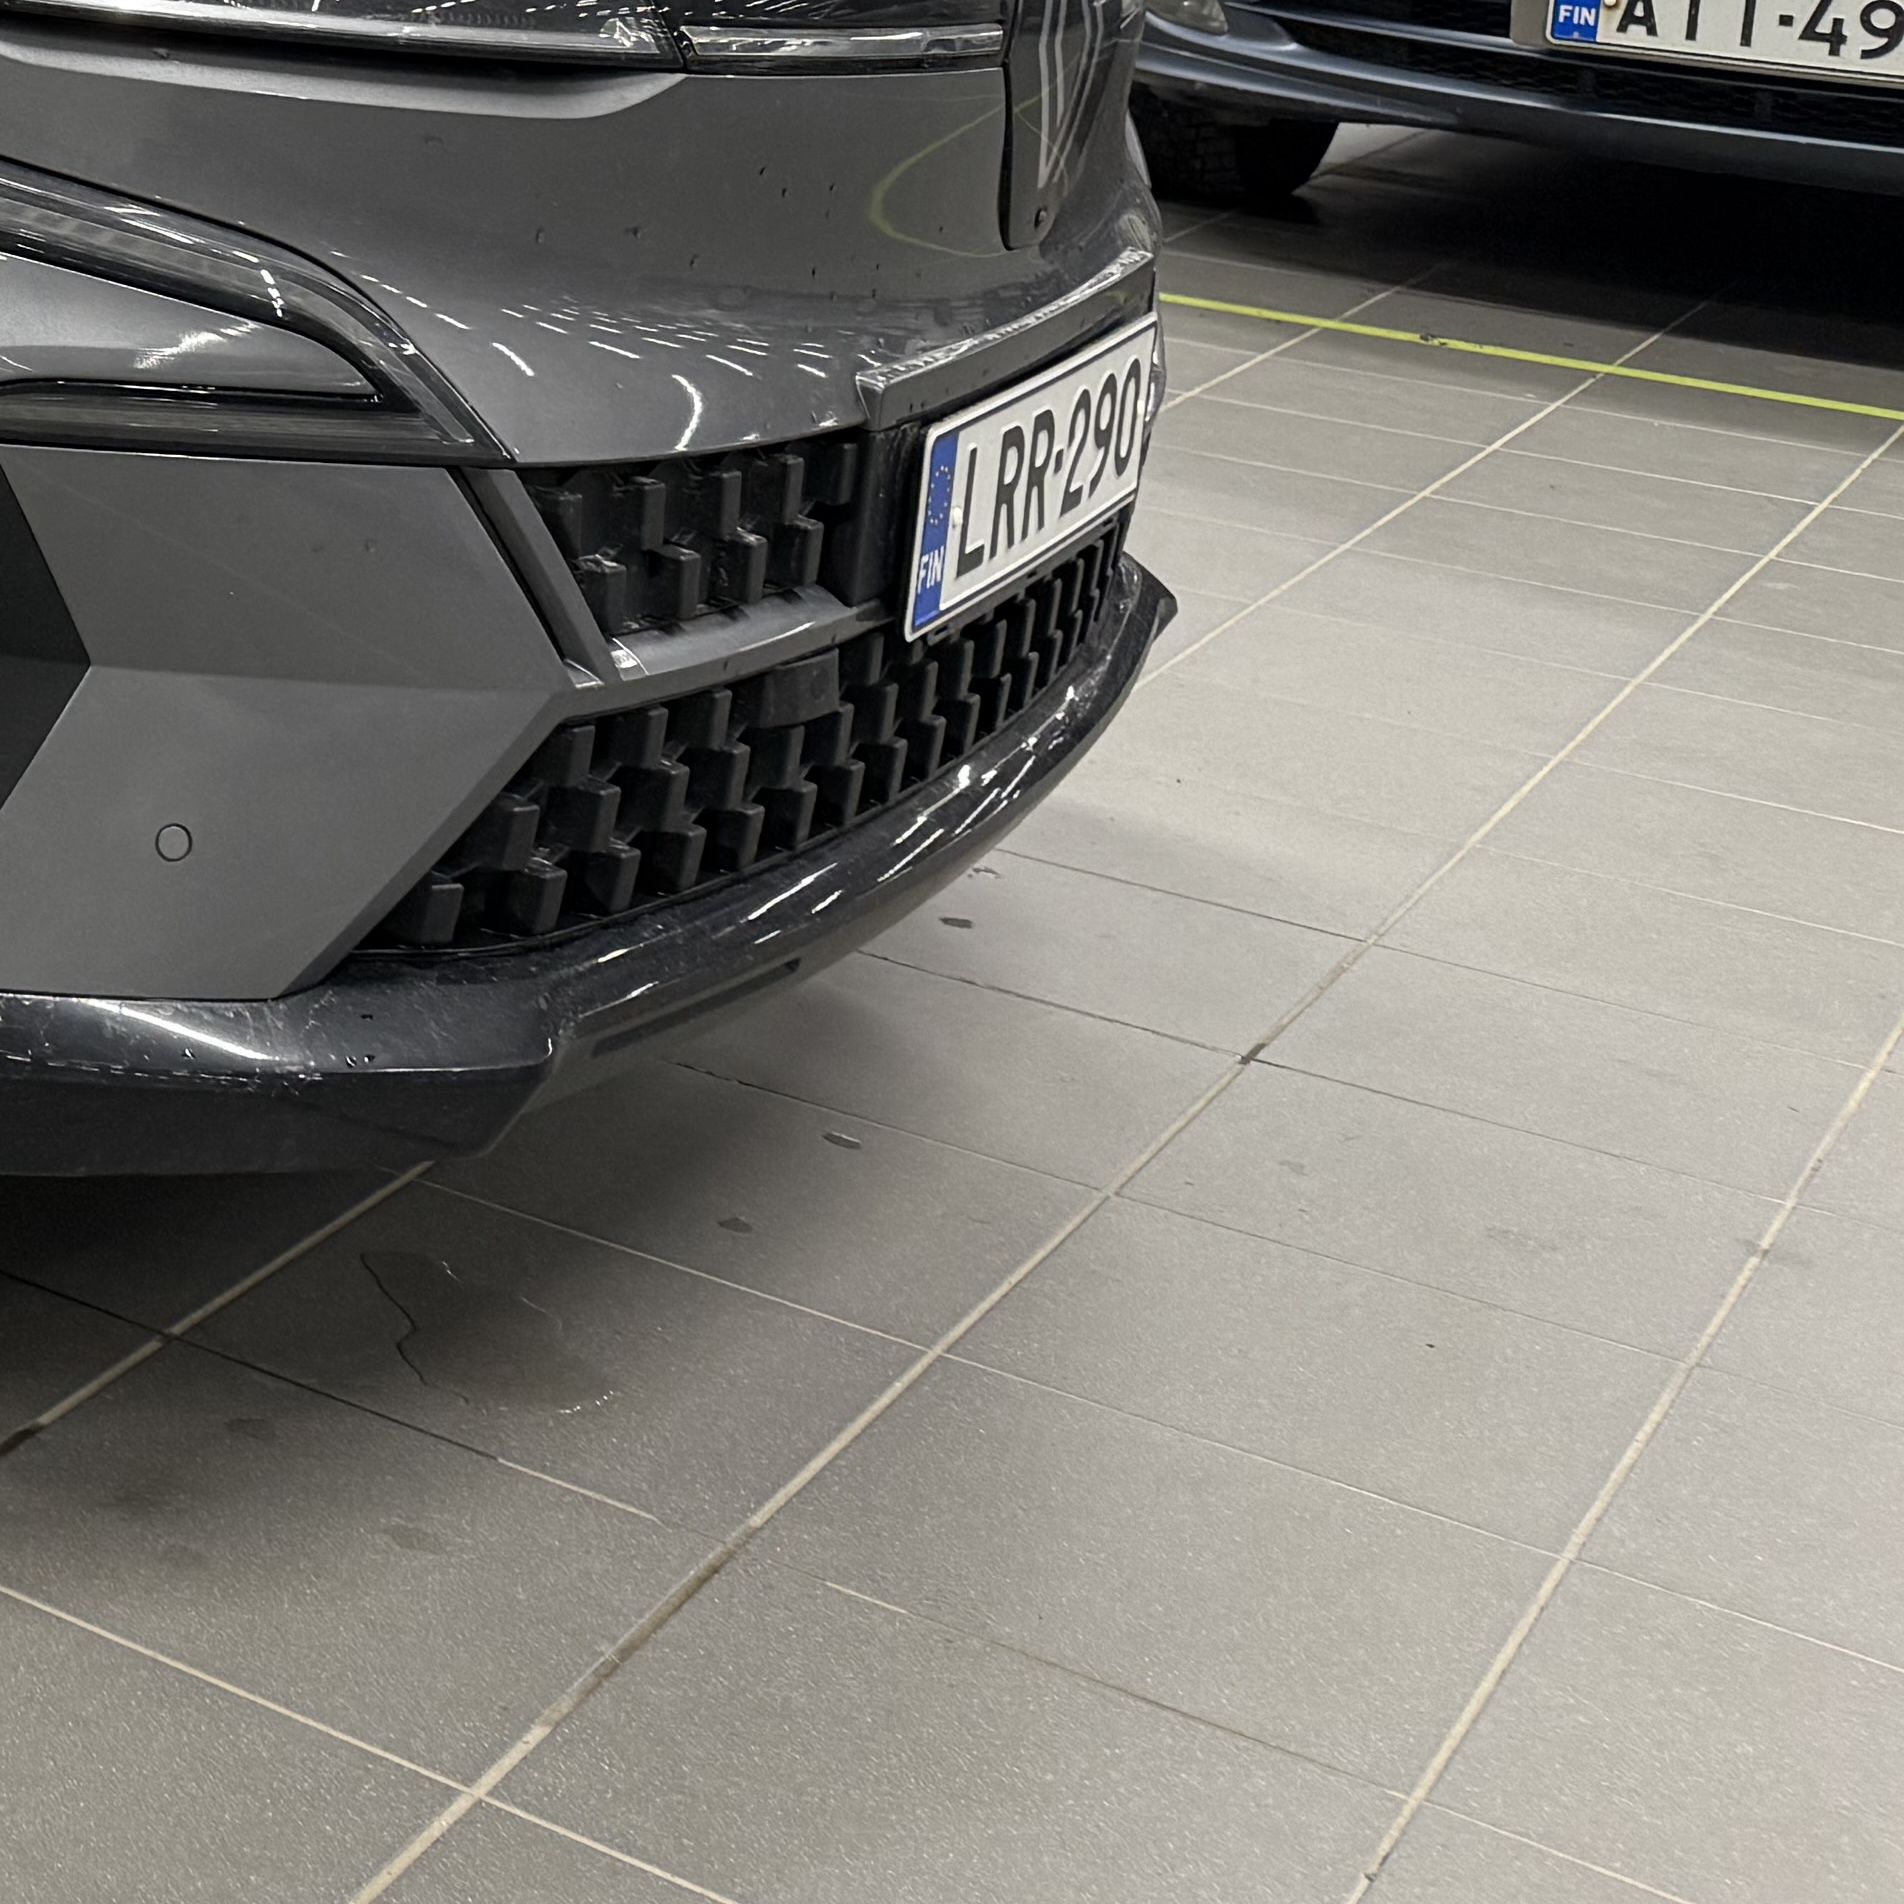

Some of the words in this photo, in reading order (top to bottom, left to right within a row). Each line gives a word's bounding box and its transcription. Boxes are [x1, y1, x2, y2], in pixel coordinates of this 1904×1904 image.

[1558, 4, 1596, 26] FIN
[917, 545, 945, 595] FIN
[956, 358, 1141, 578] LRR-290
